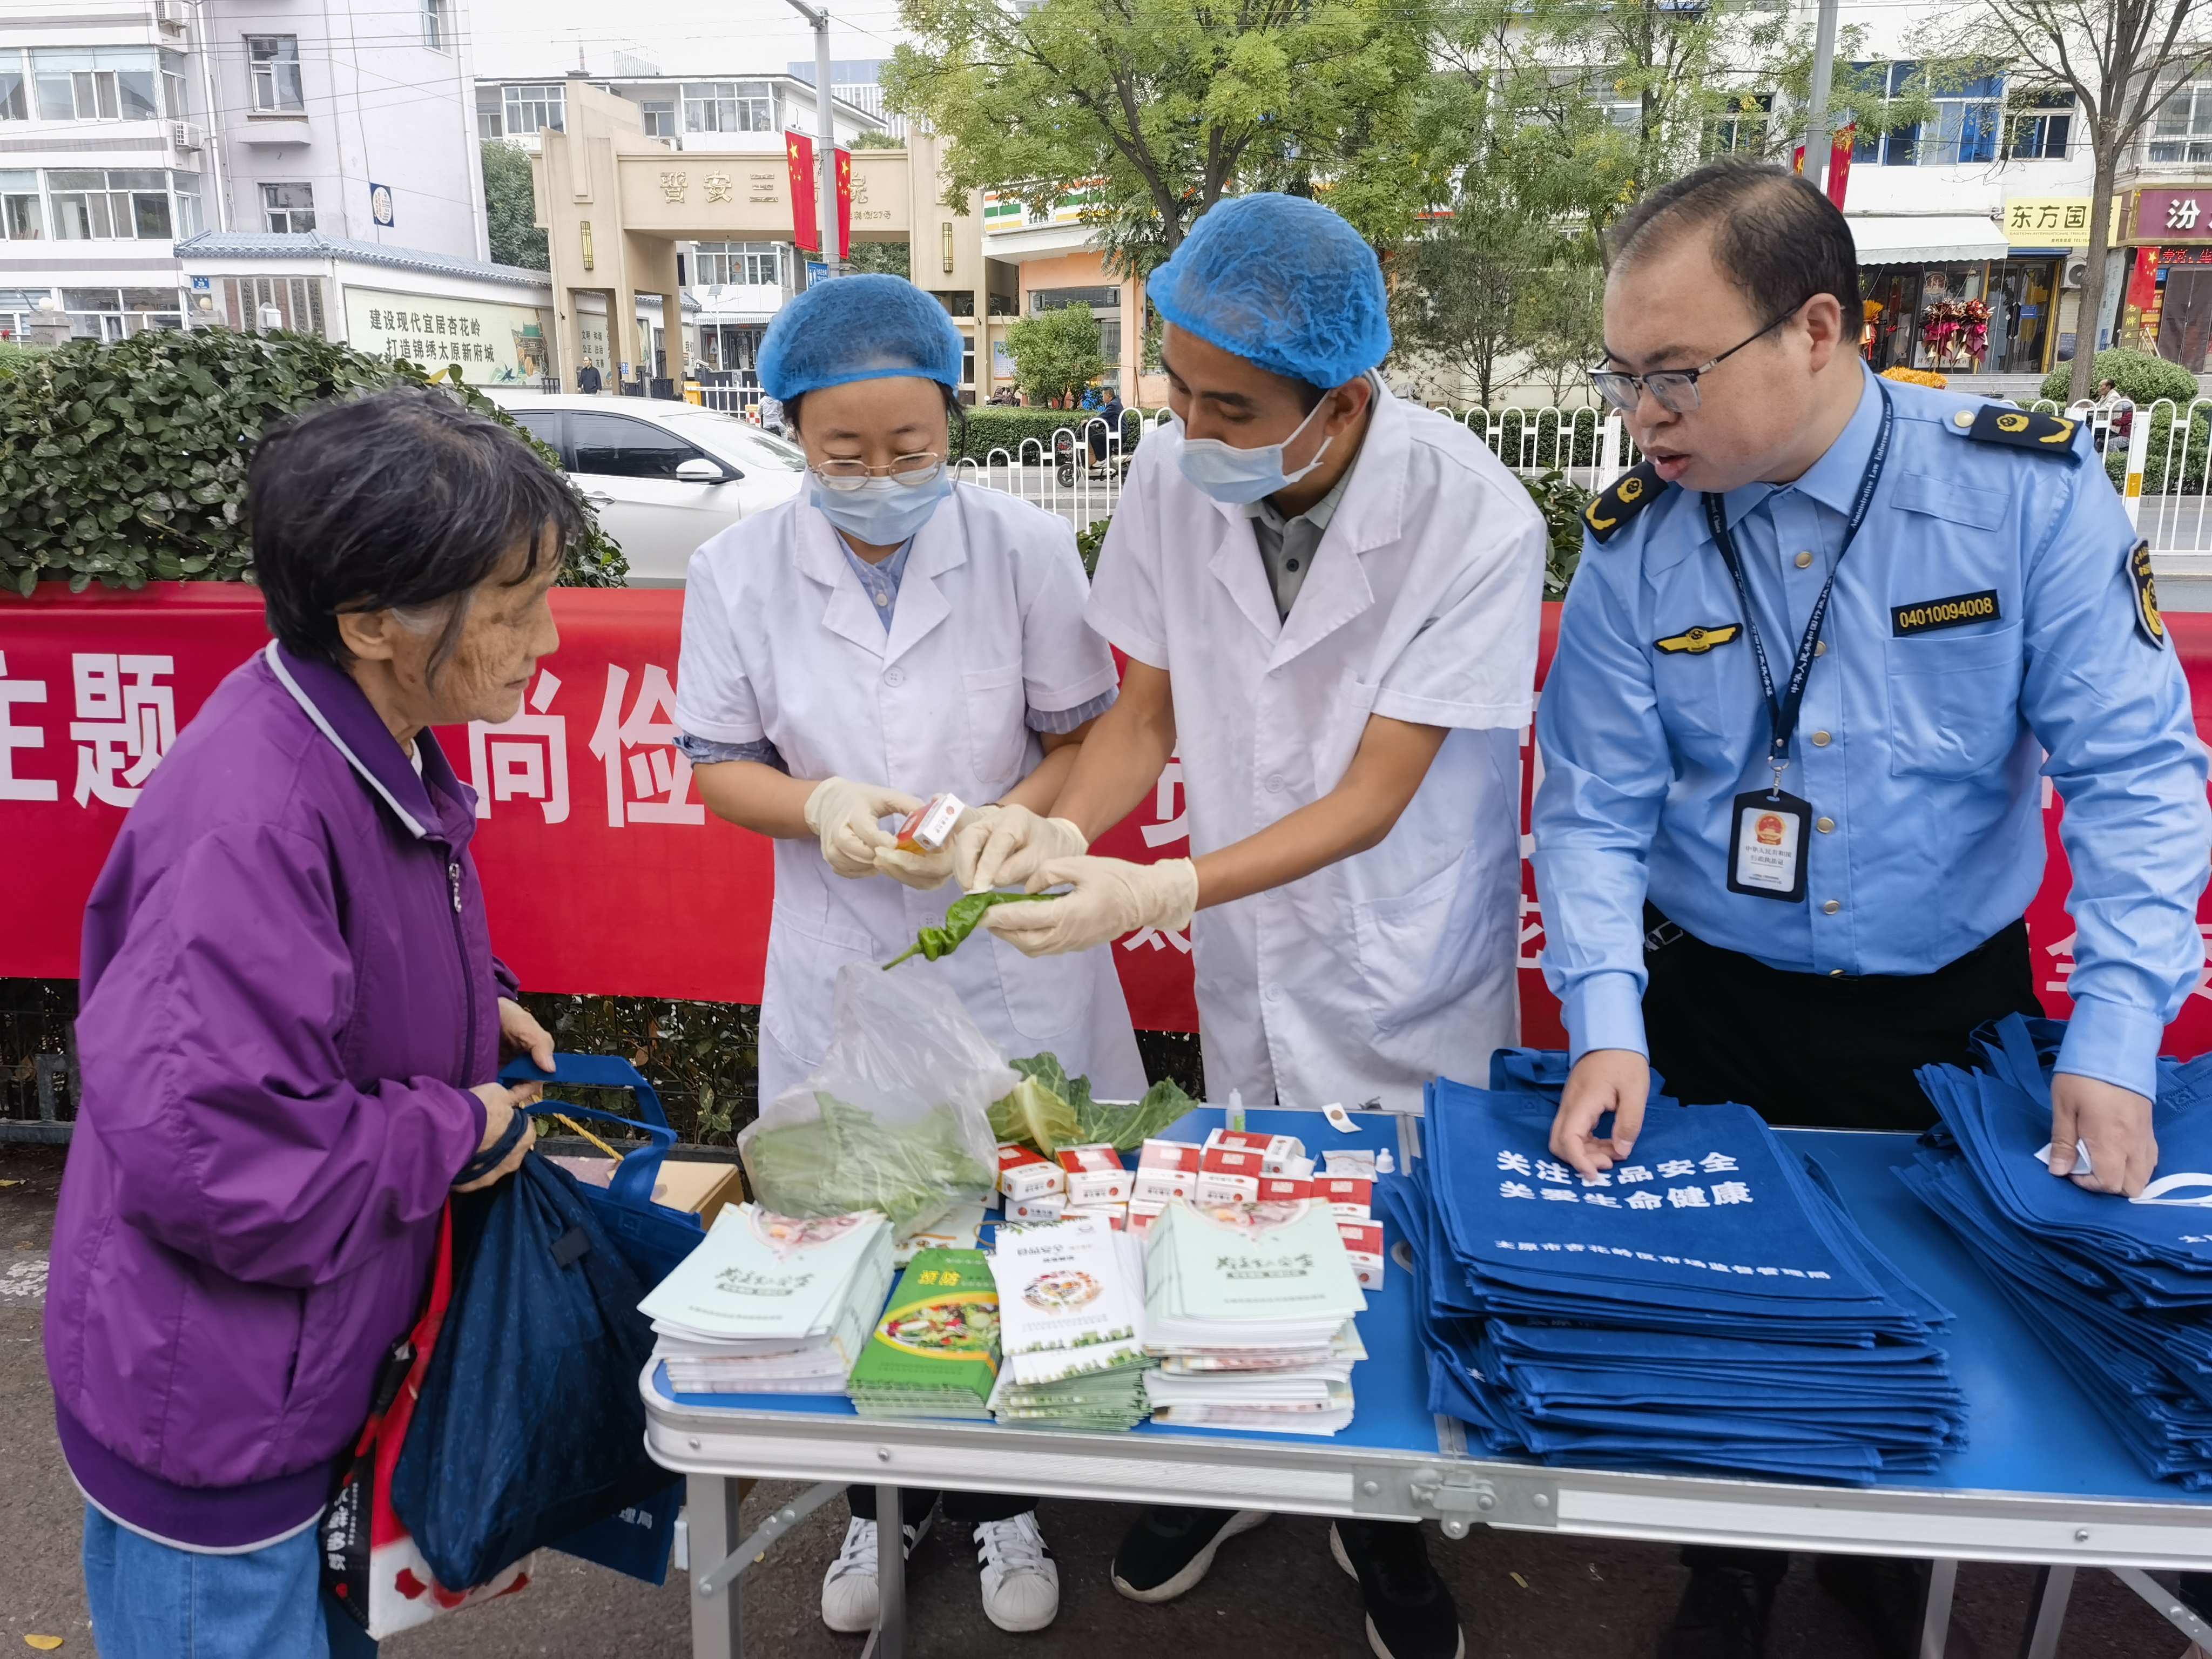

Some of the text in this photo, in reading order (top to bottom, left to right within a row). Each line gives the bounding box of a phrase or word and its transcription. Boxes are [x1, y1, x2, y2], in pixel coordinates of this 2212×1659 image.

[660, 170, 868, 204] 晋安三院
[2011, 205, 2112, 229] 东方国
[2166, 198, 2212, 230] 汾
[369, 308, 481, 338] 建设现代宜居杏花岭
[386, 337, 495, 363] 打造锦绣太原新府城
[1850, 480, 1874, 529] Administrative
[1868, 463, 1880, 478] Law
[1874, 421, 1891, 461] Enforcement
[1899, 597, 1994, 628] 04010094008
[468, 662, 705, 830] 尚俭
[1745, 845, 1792, 858] 中华人民共和国
[1499, 1180, 1754, 1210] 关爱生命健康
[1494, 1240, 1831, 1279] 太原市杏花岭区市场监督管理局
